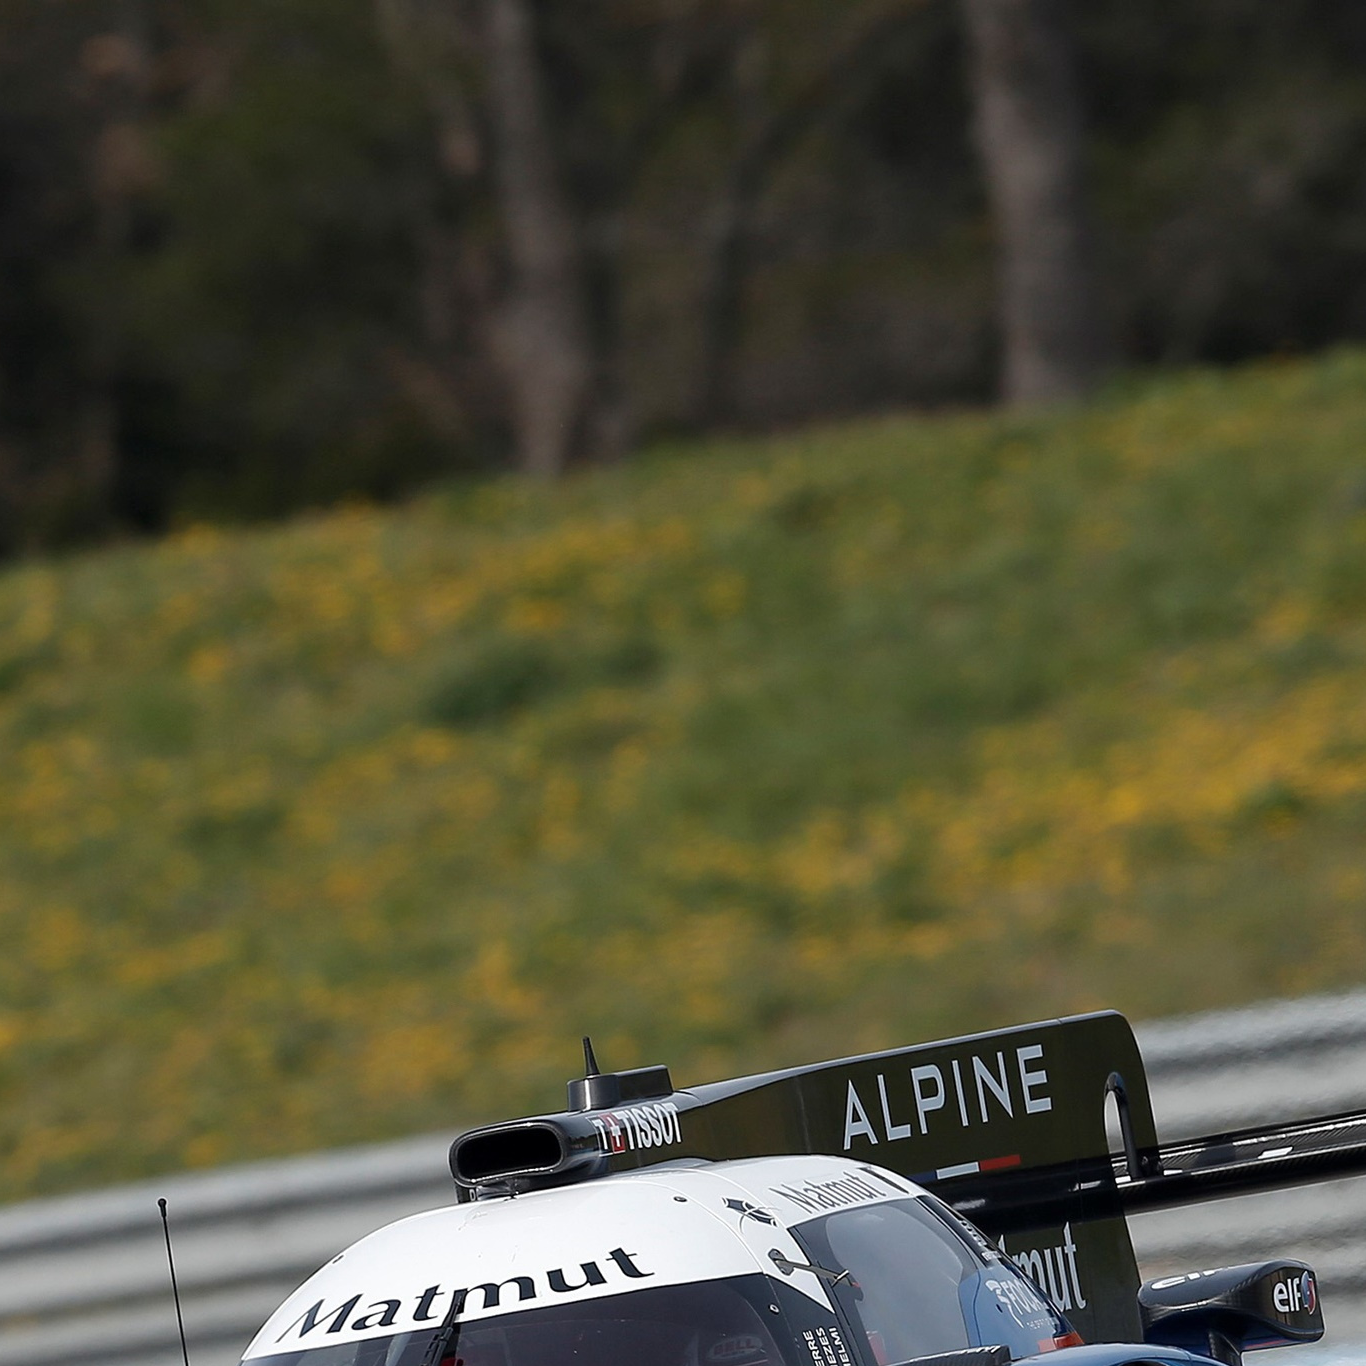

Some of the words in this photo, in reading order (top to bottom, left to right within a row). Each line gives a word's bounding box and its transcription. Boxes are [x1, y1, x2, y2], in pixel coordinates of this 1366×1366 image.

[843, 1043, 1053, 1150] ALPINE
[614, 1102, 683, 1150] TISSOT
[768, 1171, 887, 1215] Matmut
[275, 1246, 654, 1344] Matmut
[1273, 1276, 1302, 1313] elf
